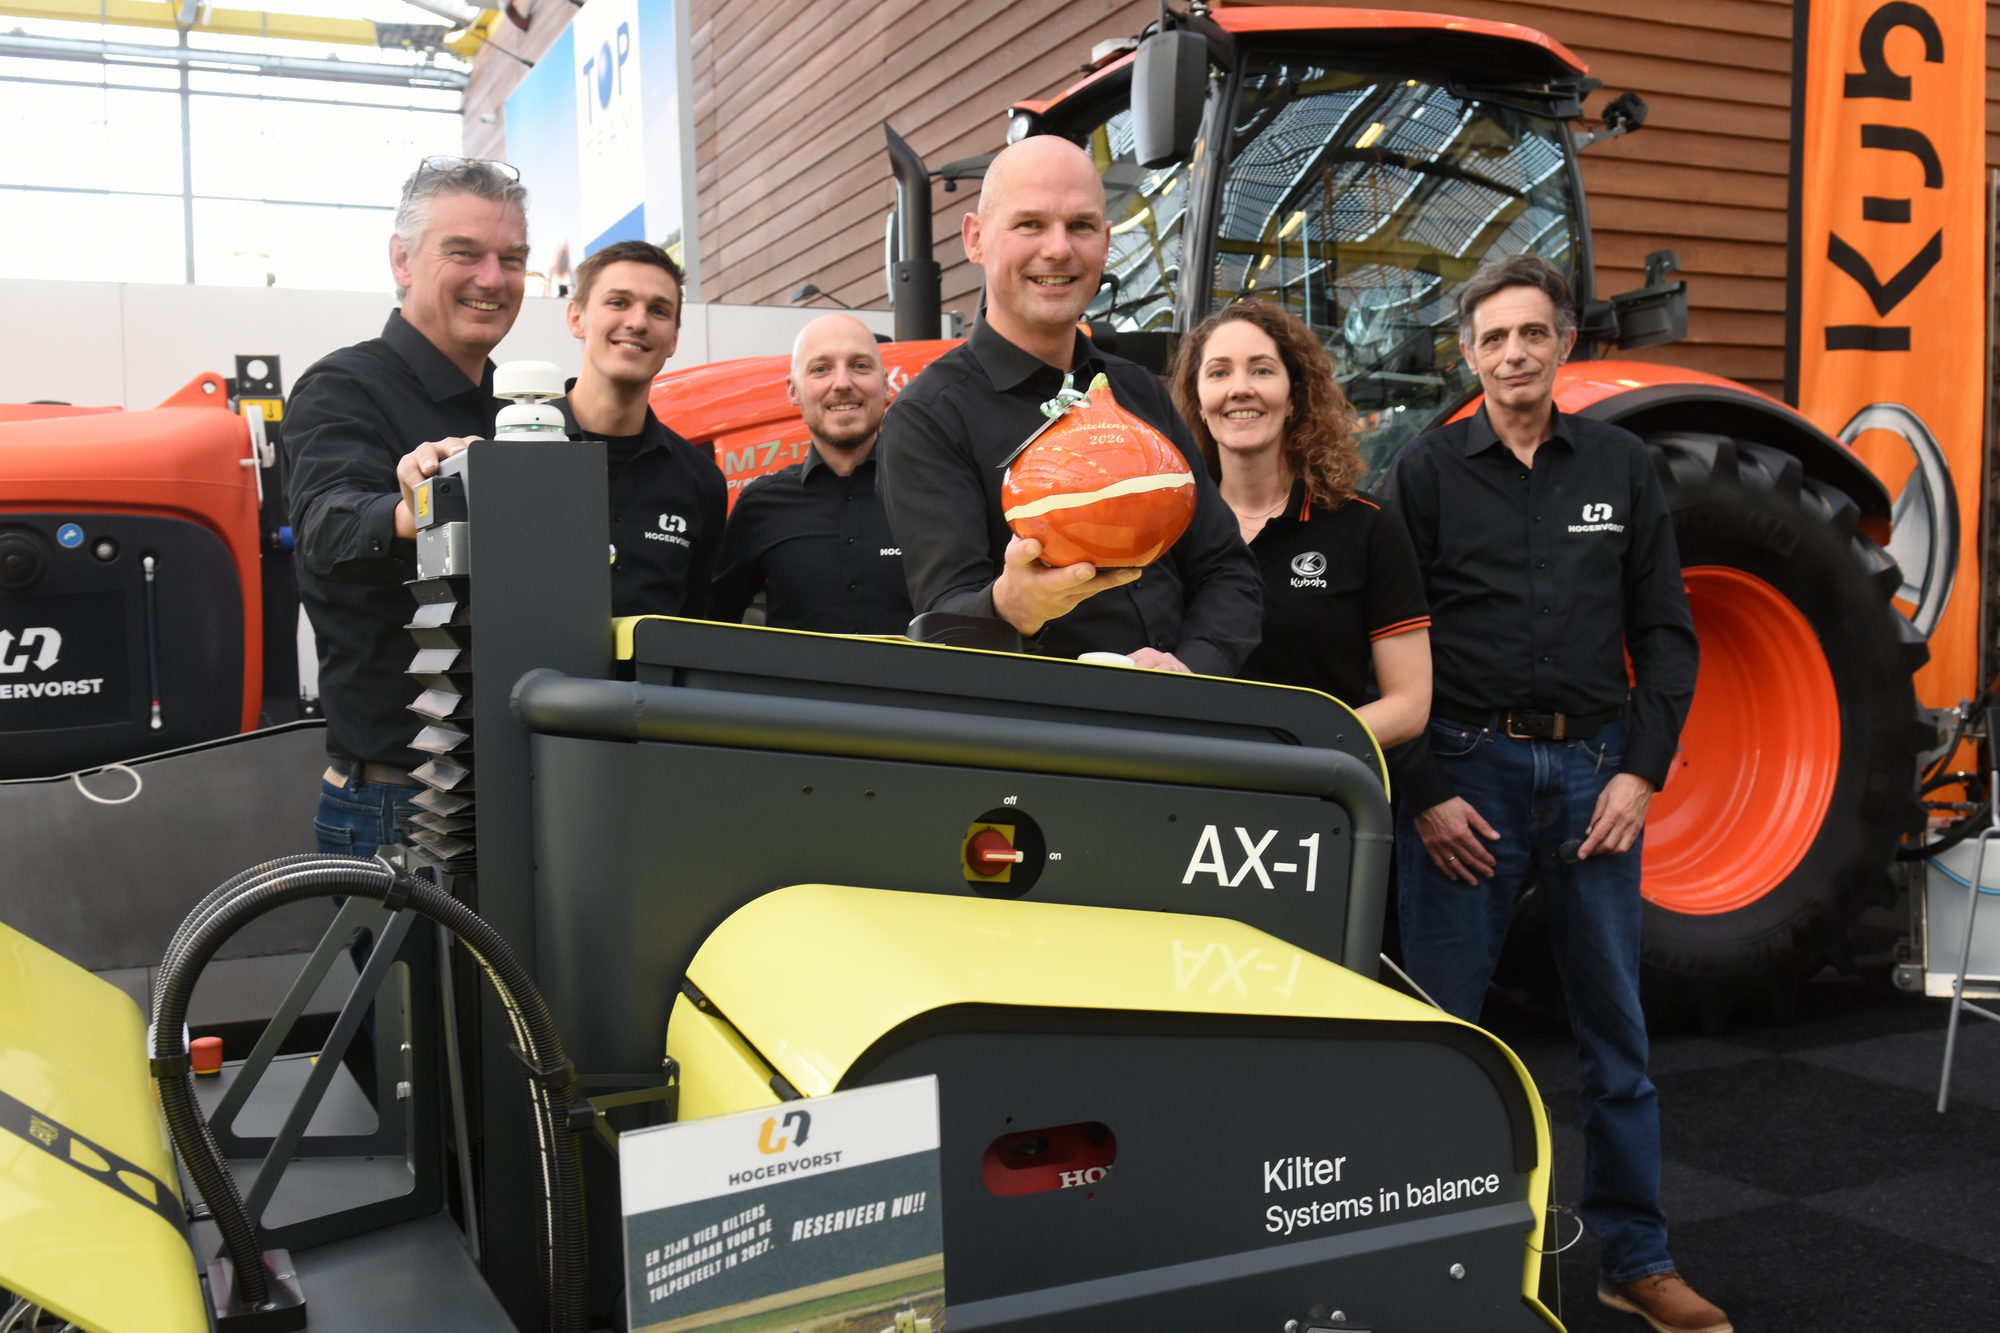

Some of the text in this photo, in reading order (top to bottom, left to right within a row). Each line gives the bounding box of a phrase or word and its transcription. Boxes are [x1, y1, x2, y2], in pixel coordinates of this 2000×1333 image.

[583, 20, 630, 126] TOP
[1089, 434, 1125, 446] 2026
[644, 531, 691, 548] HOGERV
[1290, 577, 1327, 588] Kubota
[1003, 796, 1018, 805] off
[1049, 852, 1062, 860] on
[1181, 824, 1320, 892] AX-1
[729, 1151, 843, 1186] HOGERVORST
[1059, 1165, 1113, 1189] HO
[1263, 1156, 1347, 1194] Kilter
[792, 1192, 926, 1242] RESERVEER NU!!
[1265, 1173, 1500, 1236] Systems in balance
[645, 1203, 765, 1267] ER ZIJN VIER KILTERS
[647, 1218, 772, 1286] BESCHIKBAAR VOOR DE
[649, 1237, 775, 1303] TULPENTEELT IN 2027.
